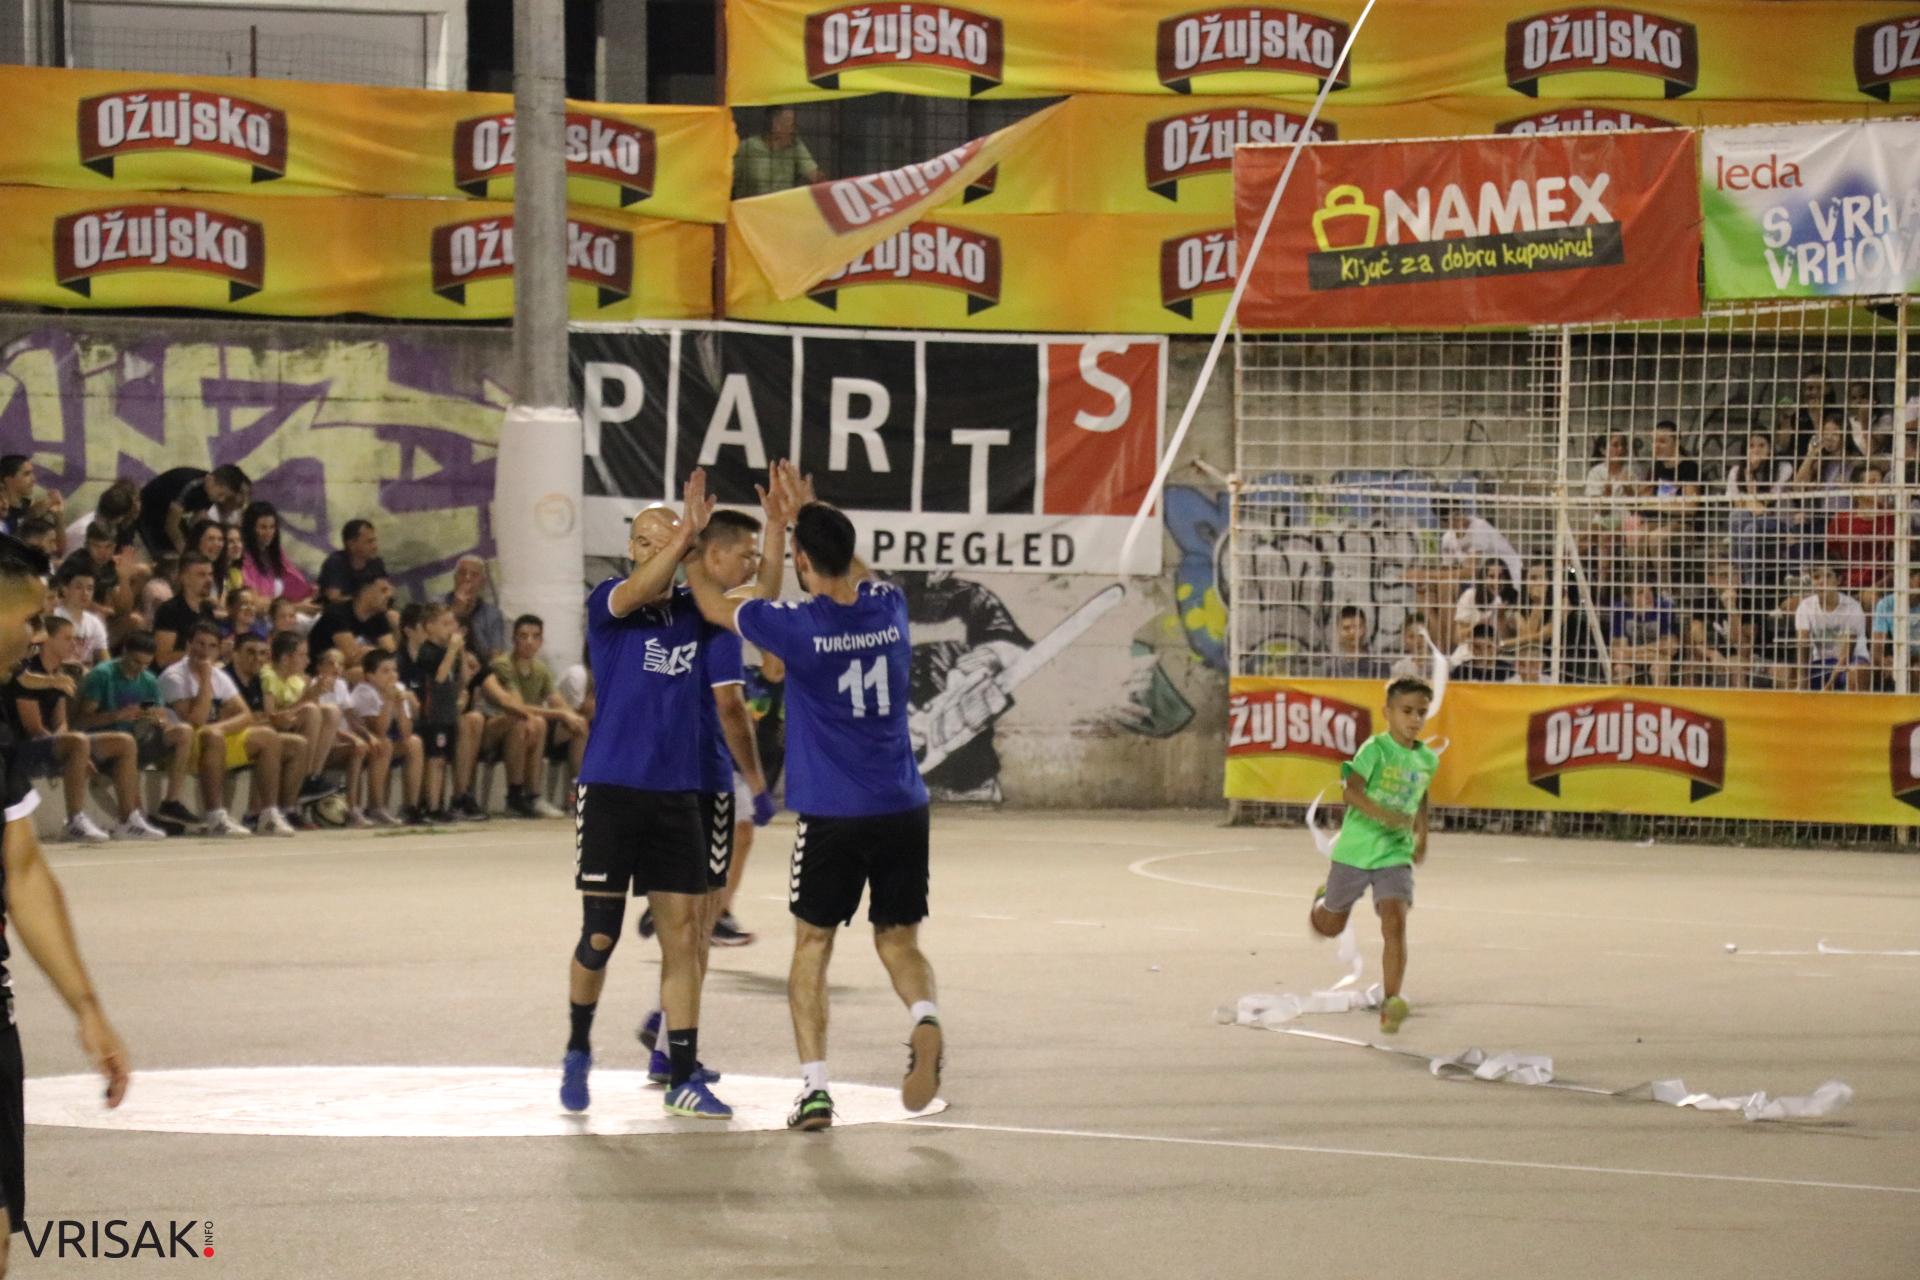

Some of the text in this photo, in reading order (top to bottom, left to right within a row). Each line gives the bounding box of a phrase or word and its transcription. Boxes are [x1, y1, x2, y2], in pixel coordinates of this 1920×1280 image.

[823, 5, 987, 64] Ožujsko
[1174, 10, 1334, 70] Ožujsko
[1523, 11, 1682, 69] Ožujsko
[97, 92, 270, 155] Ožujsko
[1163, 110, 1322, 171] Ožujsk
[1716, 154, 1804, 192] leda
[73, 207, 248, 270] Ožujsko
[1384, 172, 1614, 245] NAMEX
[1763, 206, 1792, 248] S
[1401, 256, 1433, 274] za
[1442, 244, 1496, 272] dobru
[1503, 228, 1593, 269] kupovinu!
[872, 530, 1075, 567] PREGLED
[838, 655, 891, 718] 11
[1545, 703, 1709, 768] Ožujsko
